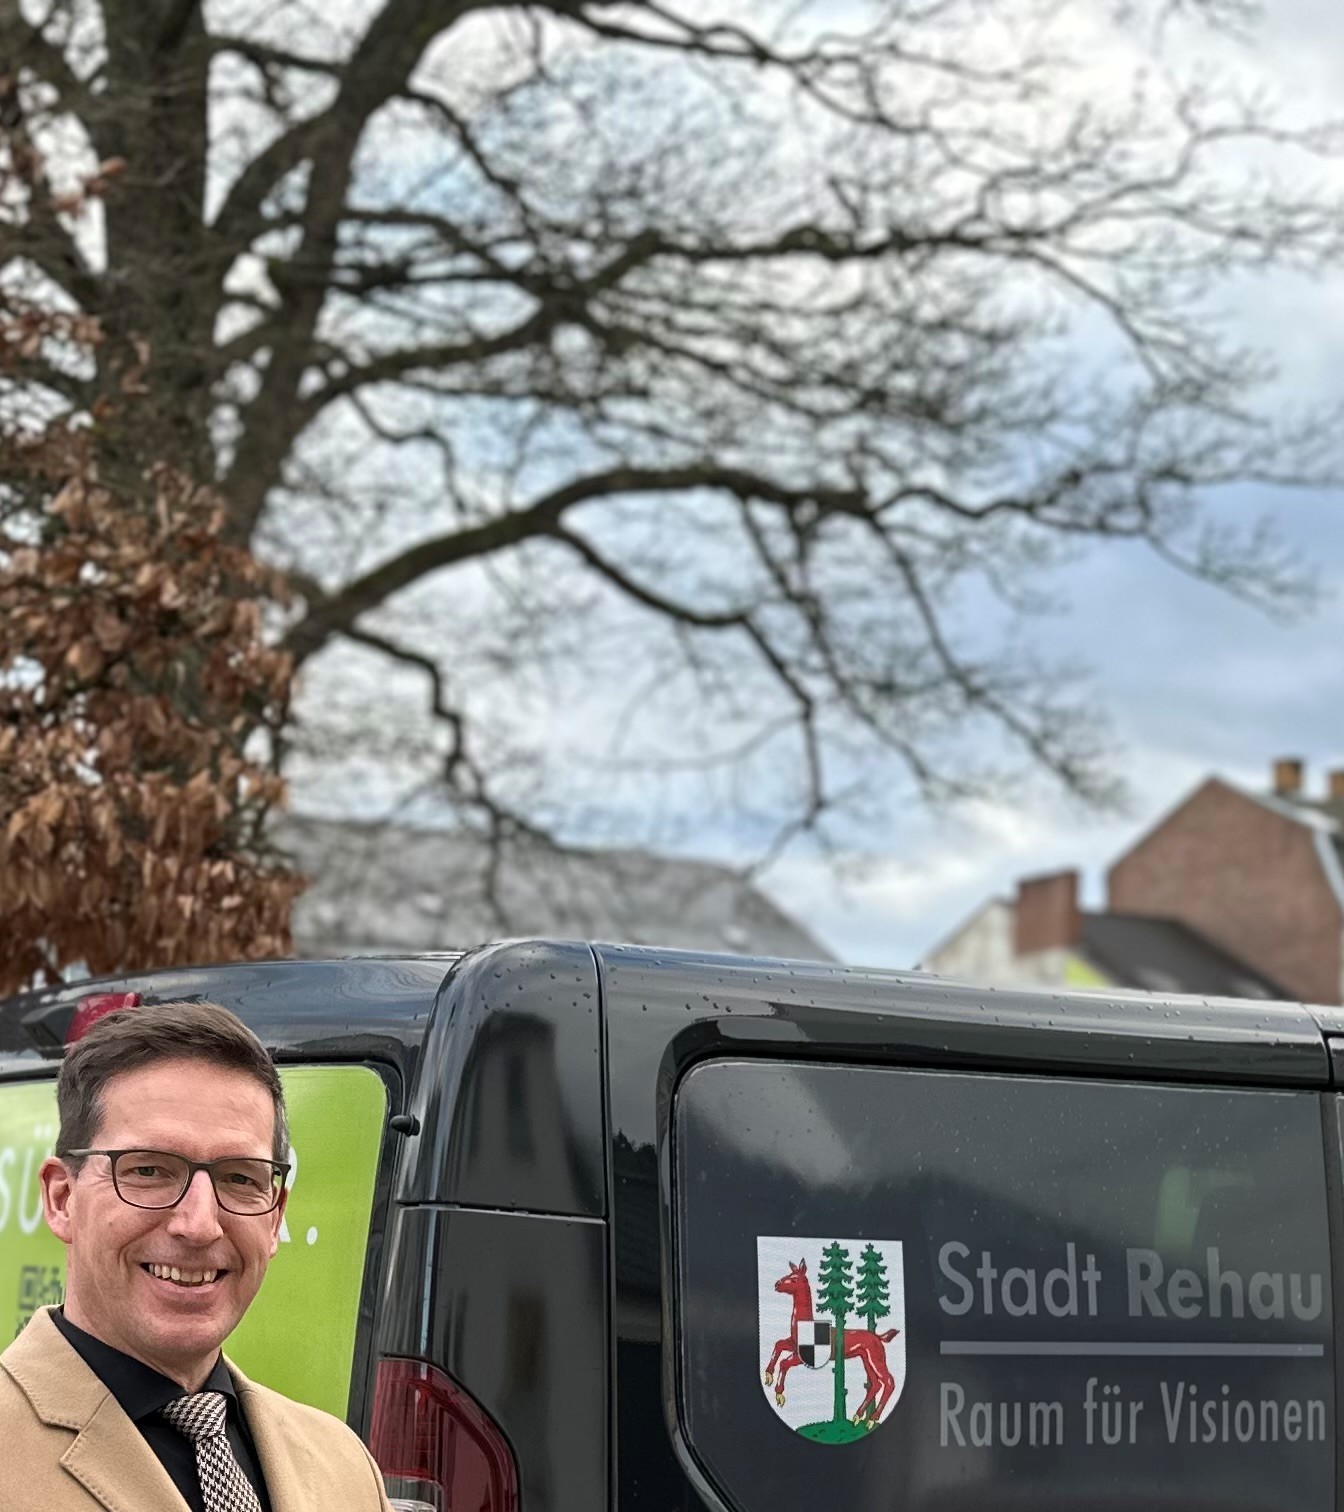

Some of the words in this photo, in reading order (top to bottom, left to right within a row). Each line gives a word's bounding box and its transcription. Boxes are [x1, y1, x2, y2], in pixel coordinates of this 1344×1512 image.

[938, 1241, 1102, 1317] Stadt
[1127, 1247, 1324, 1319] Rehau
[940, 1381, 1064, 1447] Raum
[1084, 1377, 1144, 1446] für
[1160, 1381, 1326, 1444] Visionen
